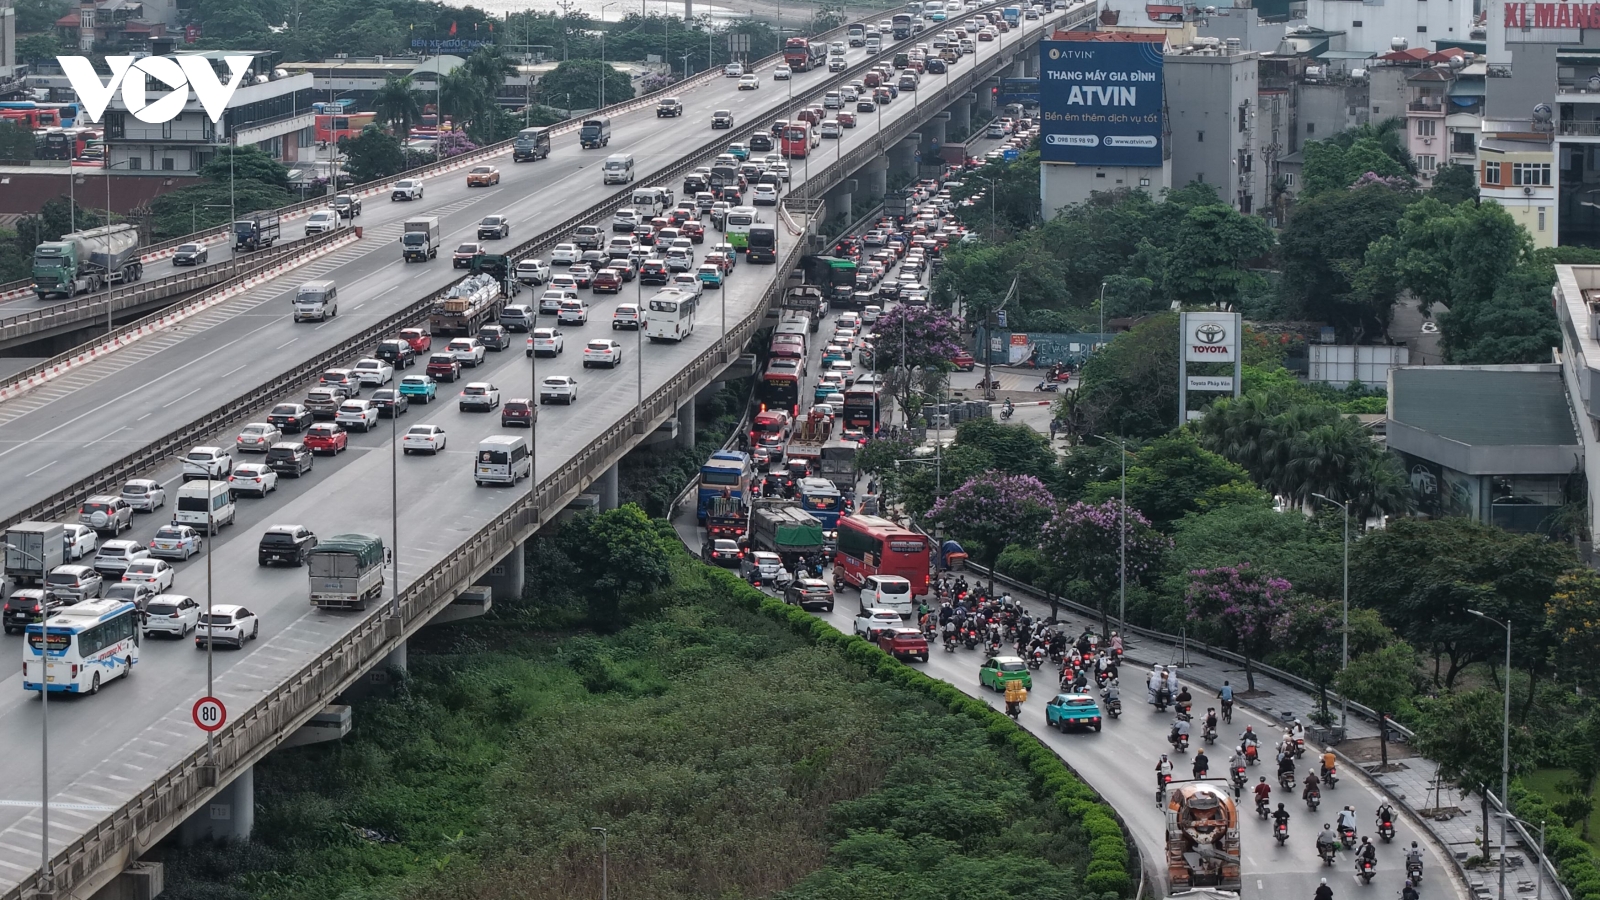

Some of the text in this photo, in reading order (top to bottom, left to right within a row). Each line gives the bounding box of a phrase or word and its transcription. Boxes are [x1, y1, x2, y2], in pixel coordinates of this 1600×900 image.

[1504, 3, 1526, 28] XI
[1047, 69, 1156, 82] THANG MÁY GIA ĐÌNH
[1066, 85, 1137, 106] ATVIN
[1082, 112, 1106, 122] thêm
[1107, 113, 1128, 124] dịch
[1130, 115, 1141, 125] vụ
[1144, 112, 1158, 123] tốt
[1192, 345, 1228, 354] TOYOTA
[202, 706, 217, 721] 80
